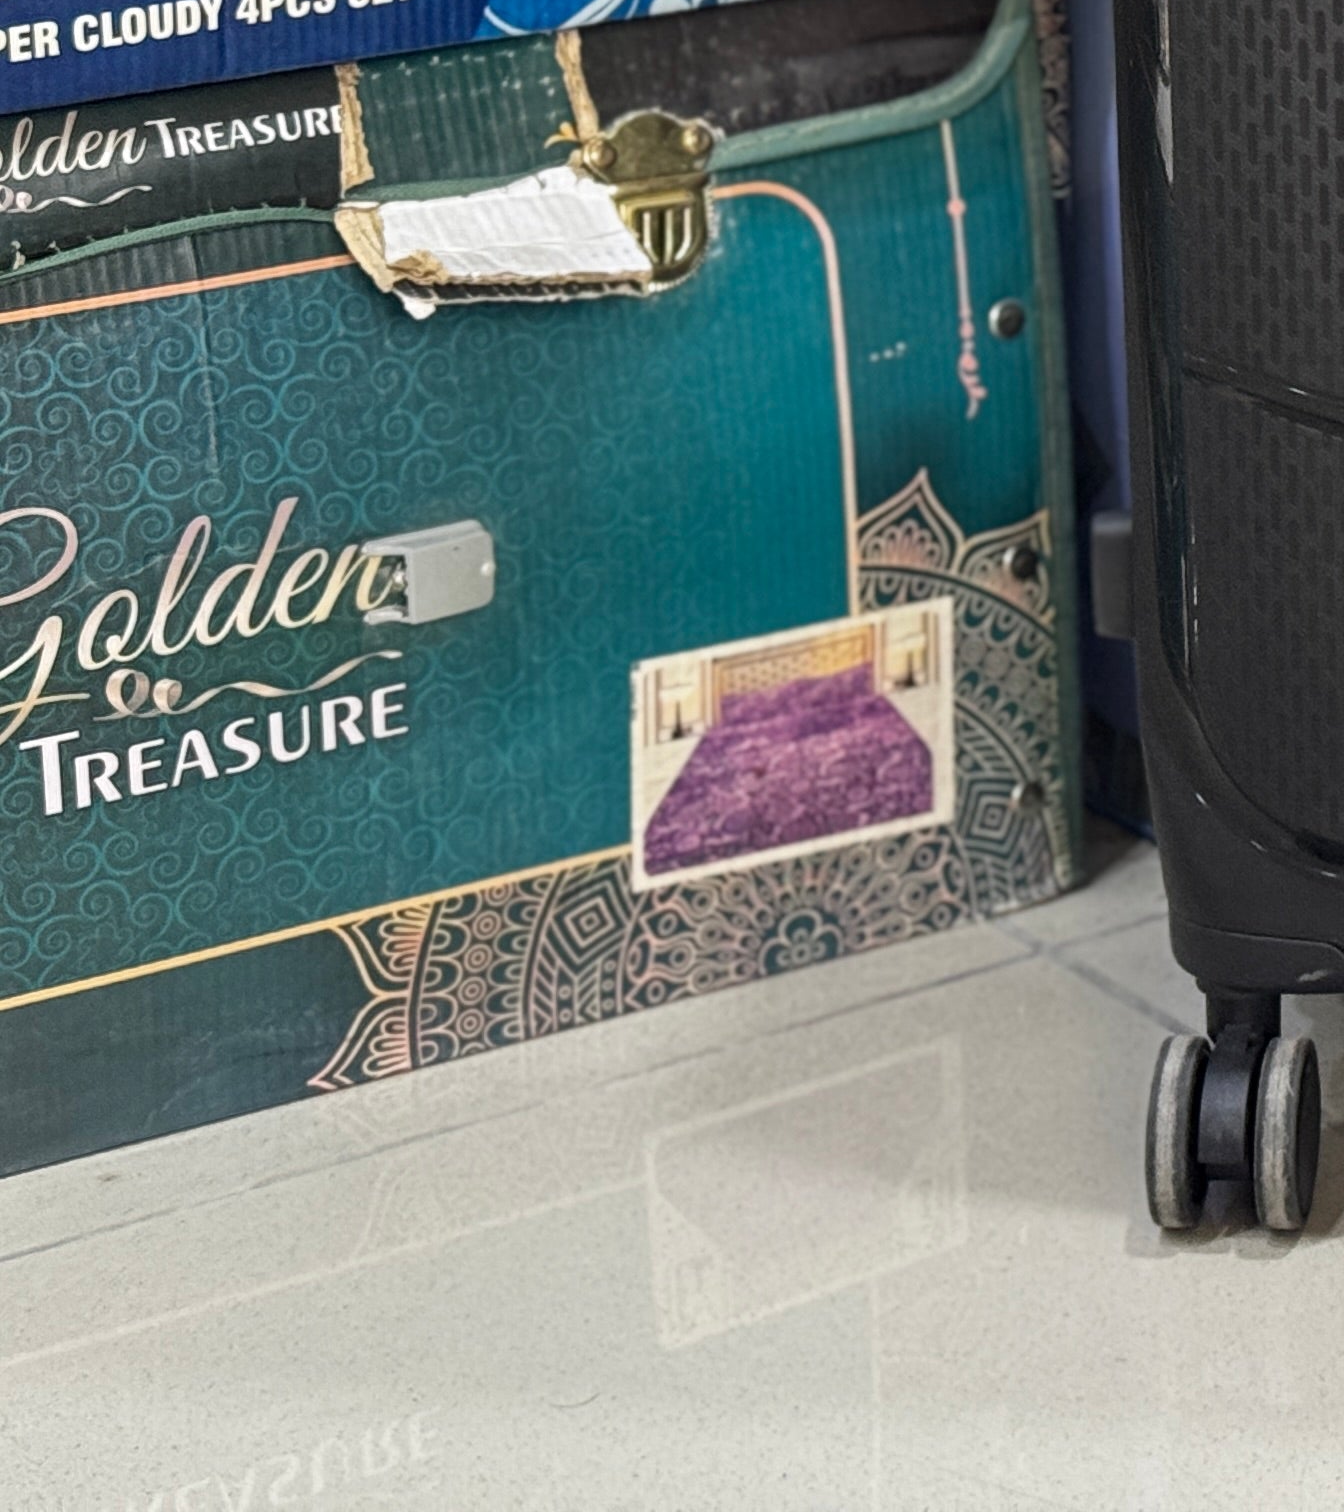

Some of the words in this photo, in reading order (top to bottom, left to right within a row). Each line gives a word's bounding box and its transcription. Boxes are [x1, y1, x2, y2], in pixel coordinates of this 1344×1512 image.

[0, 20, 61, 64] ER
[0, 496, 395, 746] Golden
[19, 681, 410, 817] TREASURE
